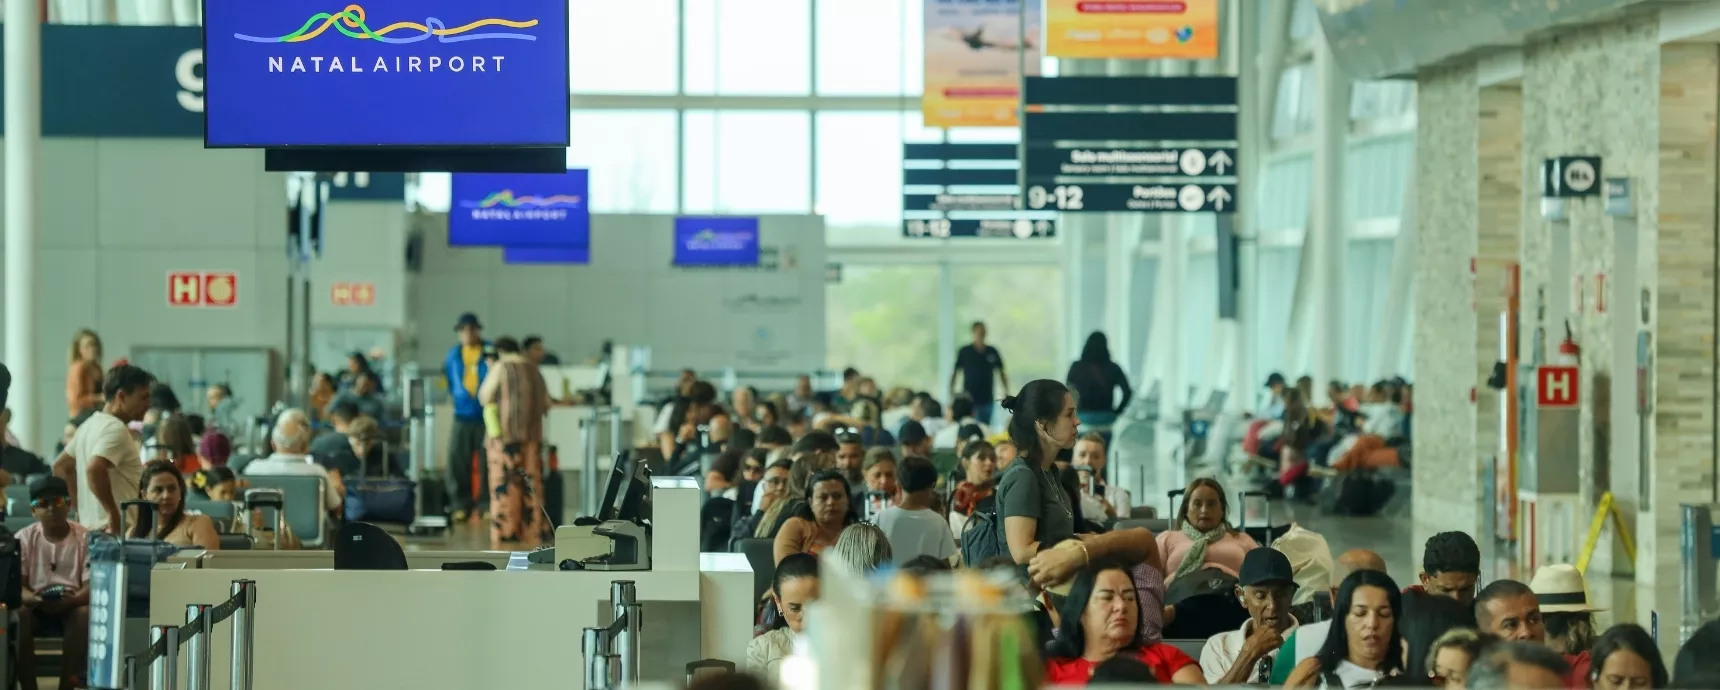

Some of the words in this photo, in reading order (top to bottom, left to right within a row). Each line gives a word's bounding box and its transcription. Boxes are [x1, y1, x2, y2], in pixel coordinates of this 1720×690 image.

[268, 56, 364, 73] NATAL
[372, 56, 506, 73] AIRPORT
[1028, 185, 1084, 210] 9-12
[173, 276, 198, 303] H
[1546, 371, 1570, 401] H
